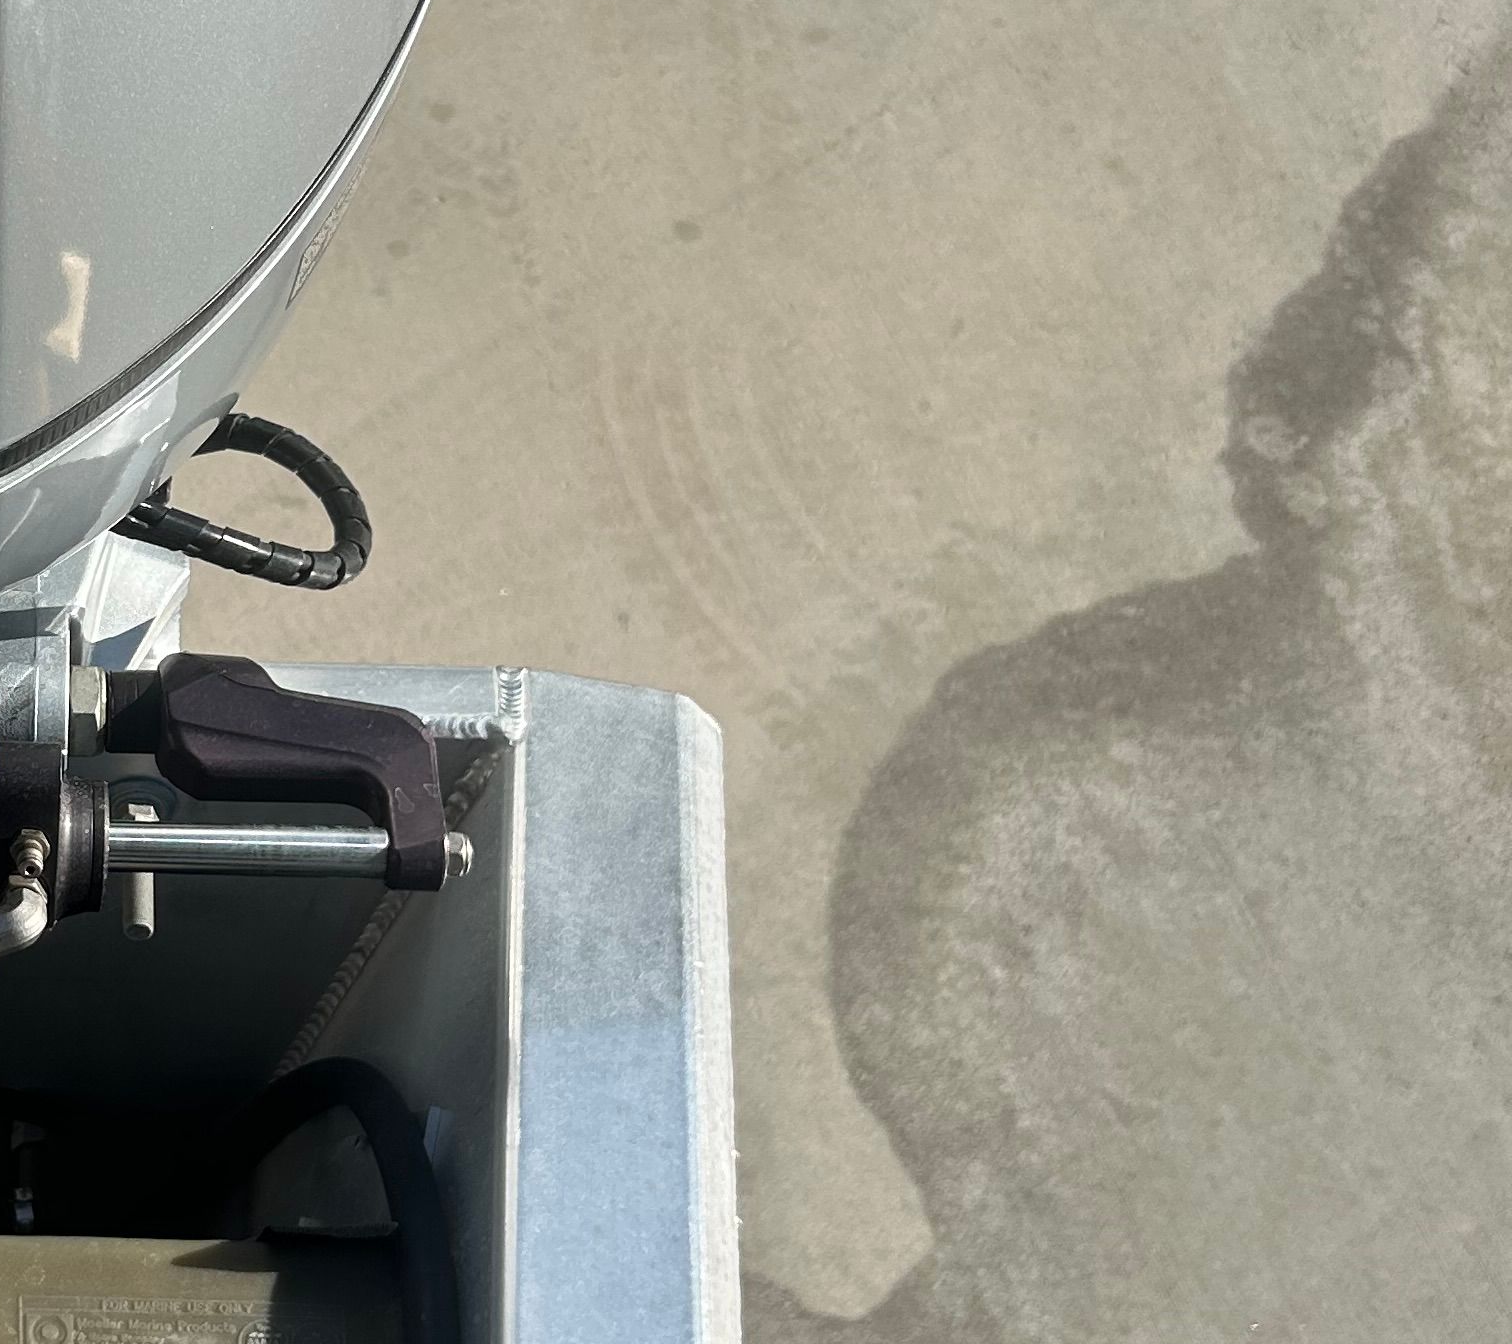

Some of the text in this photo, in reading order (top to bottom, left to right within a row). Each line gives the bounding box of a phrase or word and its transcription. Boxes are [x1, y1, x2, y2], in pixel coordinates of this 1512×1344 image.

[102, 1301, 129, 1312] FOR
[135, 1301, 177, 1312] MARINE
[219, 1303, 254, 1313] ONLY
[129, 1320, 172, 1331] Marine
[177, 1321, 237, 1334] Products
